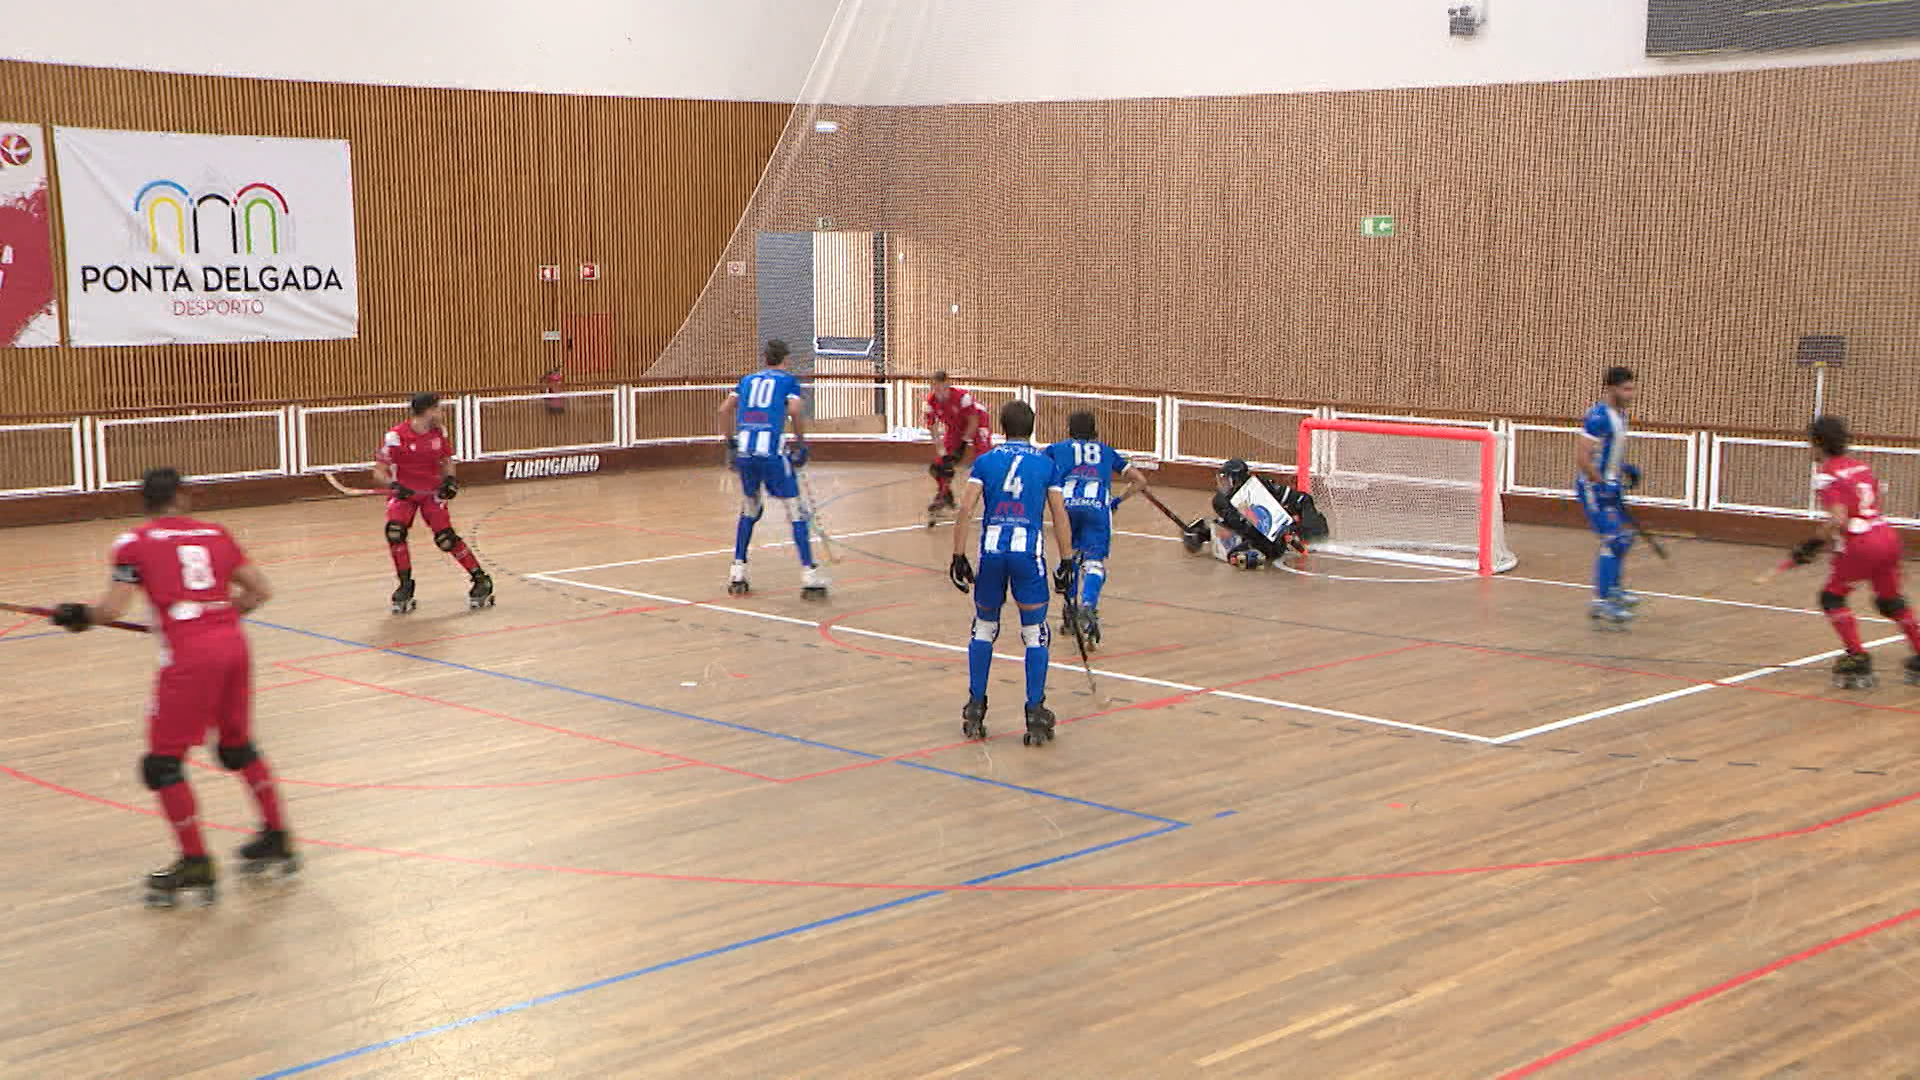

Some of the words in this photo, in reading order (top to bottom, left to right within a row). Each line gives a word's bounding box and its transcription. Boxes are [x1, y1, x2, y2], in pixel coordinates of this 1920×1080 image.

[80, 265, 194, 293] PONTA
[202, 265, 344, 292] DELGADA
[172, 299, 265, 317] DESPORTO
[748, 376, 777, 408] 10
[505, 453, 600, 480] FABRIGIMNO
[1071, 442, 1102, 466] 18
[1003, 455, 1025, 500] 4
[175, 544, 217, 590] 8
